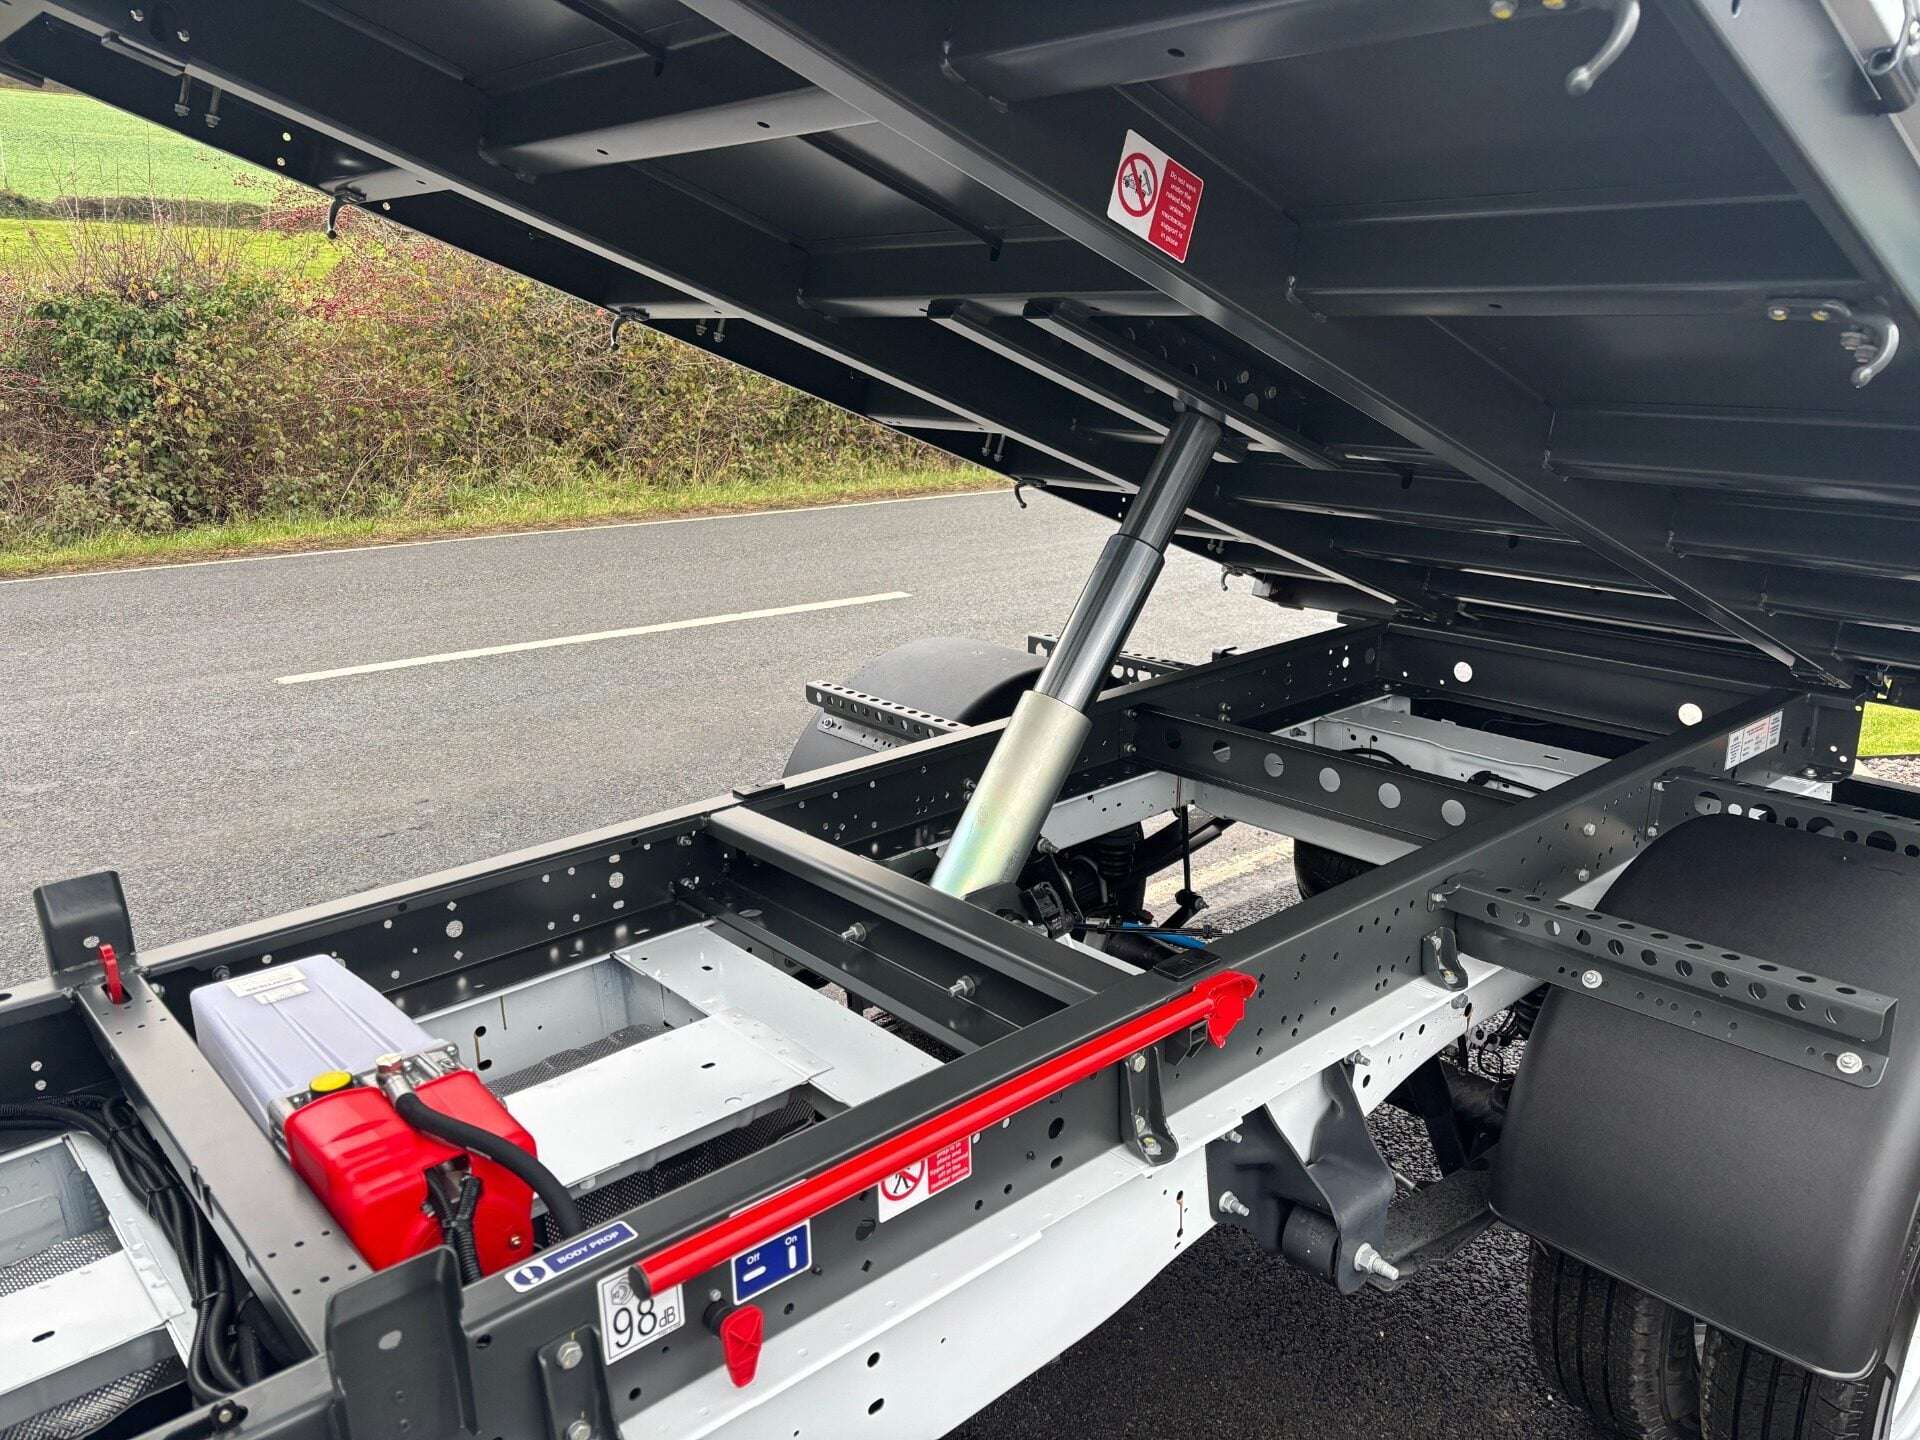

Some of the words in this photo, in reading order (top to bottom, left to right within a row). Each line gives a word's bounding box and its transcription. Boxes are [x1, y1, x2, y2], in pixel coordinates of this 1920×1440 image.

[1171, 184, 1184, 196] under
[1186, 182, 1196, 193] work
[1166, 191, 1180, 205] raised
[1180, 200, 1191, 213] body
[1169, 205, 1184, 217] unless
[1160, 221, 1178, 236] support
[1161, 210, 1187, 230] mechanical
[1166, 235, 1178, 247] place
[556, 1245, 588, 1264] BODY
[589, 1231, 619, 1249] PROP
[746, 1252, 760, 1265] Off
[784, 1235, 798, 1246] On
[613, 1298, 657, 1348] 98
[659, 1306, 676, 1328] dB
